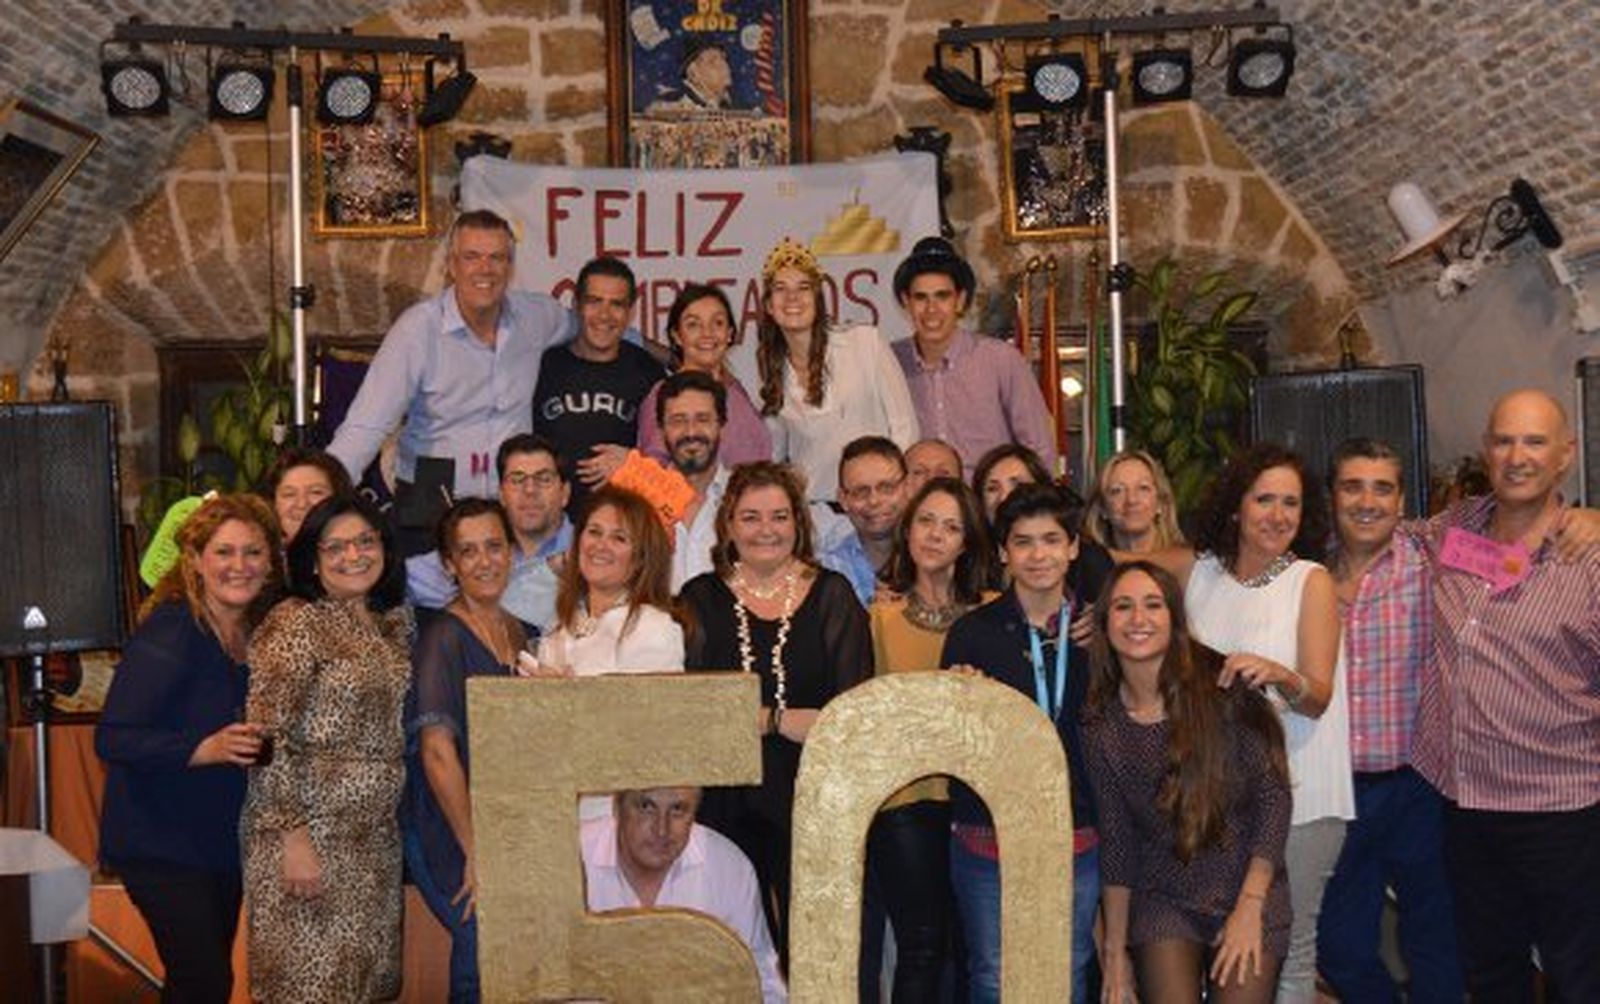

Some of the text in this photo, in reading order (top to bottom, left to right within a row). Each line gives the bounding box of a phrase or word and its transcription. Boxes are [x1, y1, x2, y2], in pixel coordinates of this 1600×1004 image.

[545, 187, 745, 259] FELIZ
[542, 391, 637, 422] GURU
[466, 671, 1073, 1004] 50
